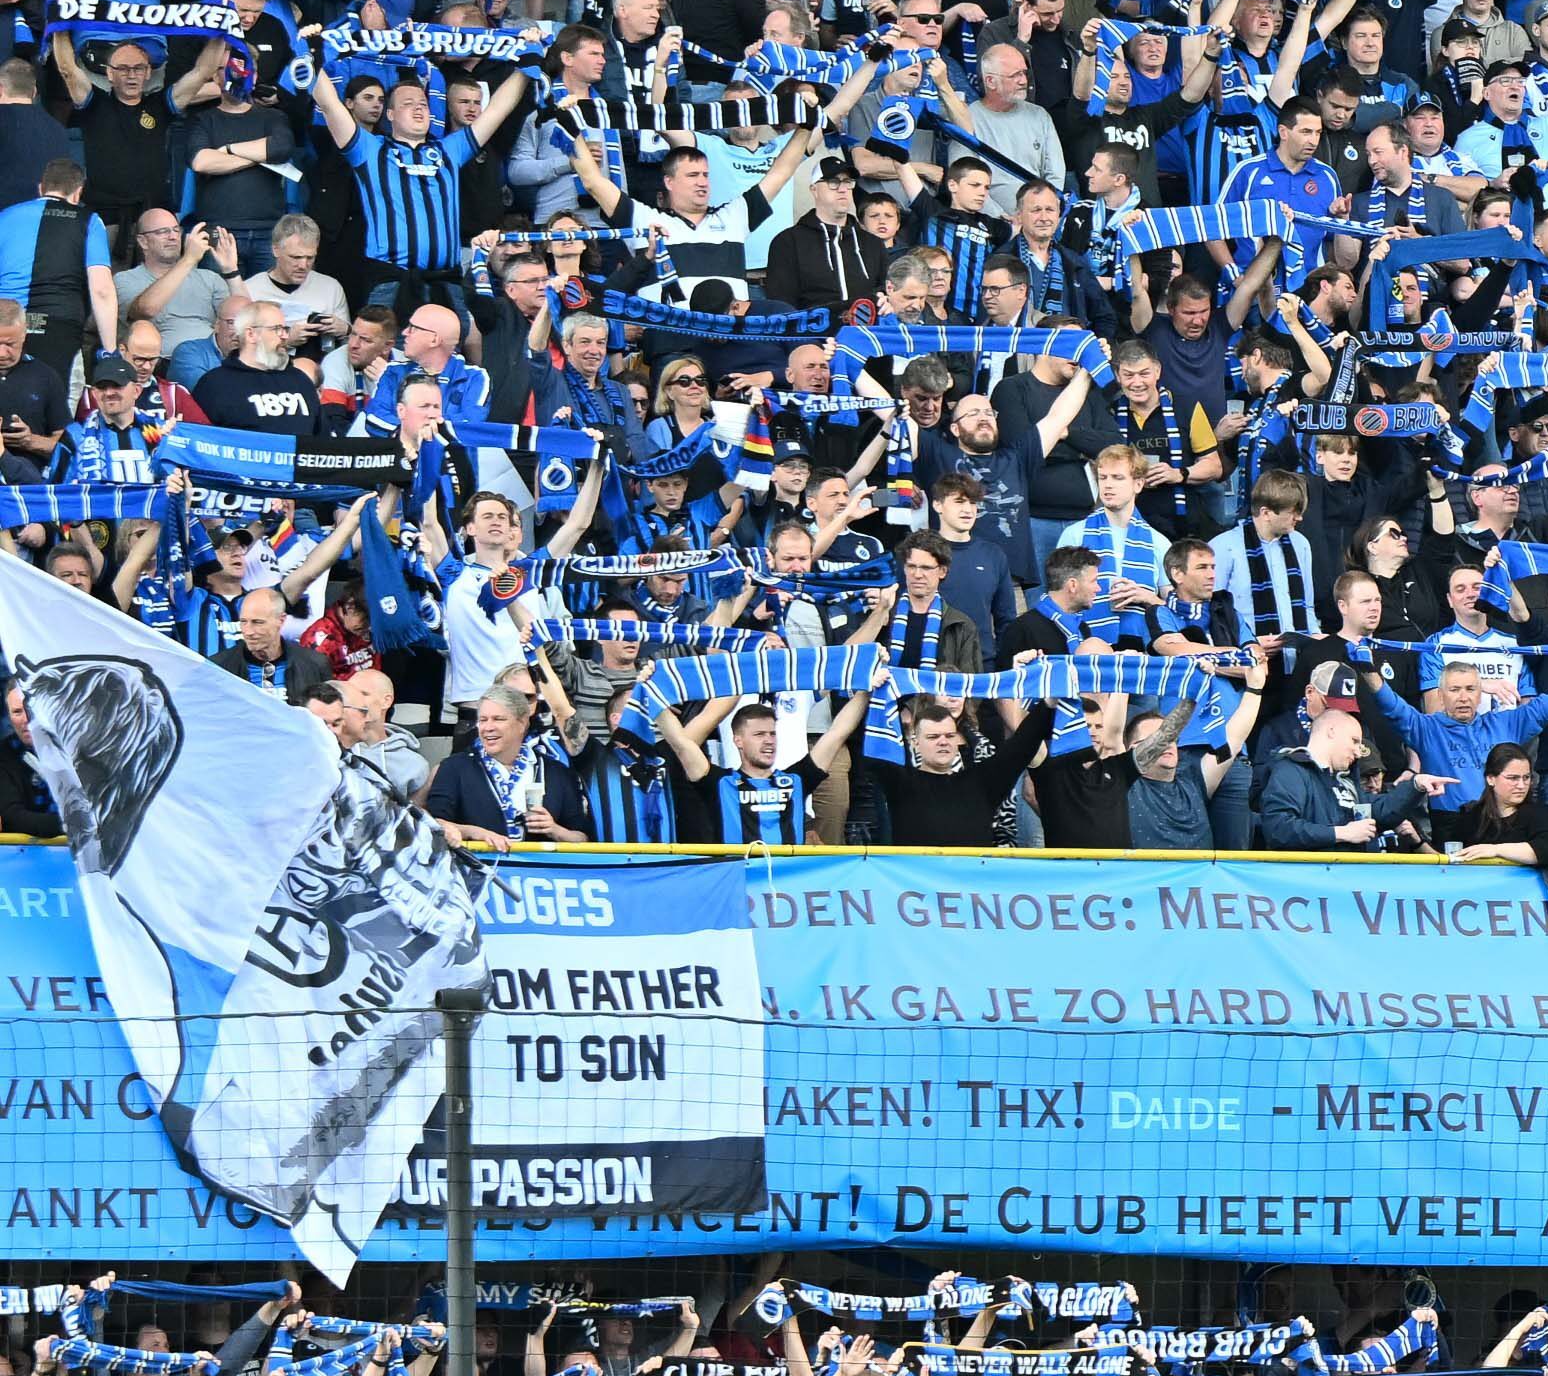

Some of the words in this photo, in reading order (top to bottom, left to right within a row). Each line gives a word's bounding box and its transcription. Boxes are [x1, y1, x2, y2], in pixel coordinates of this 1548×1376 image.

[327, 28, 406, 54] CLUB
[410, 30, 527, 61] BRUGGE
[248, 391, 310, 417] 1891
[898, 892, 1137, 932] GENOEG:
[568, 965, 722, 1011] FATHER
[821, 983, 877, 1023] IK
[891, 985, 966, 1024] GA
[980, 985, 1039, 1025] JE
[1055, 987, 1128, 1026] ZO
[1144, 986, 1292, 1028] HARD
[1313, 989, 1516, 1031] MISSEN
[505, 1034, 563, 1082] TO
[578, 1032, 668, 1083] SON
[475, 1155, 654, 1209] PASSION
[1175, 1195, 1353, 1237] HEEFT
[1379, 1196, 1521, 1239] VEEL
[800, 1288, 830, 1312] WE
[832, 1291, 884, 1316] NEVER
[887, 1291, 926, 1316] WALK
[929, 1284, 994, 1312] ALONE
